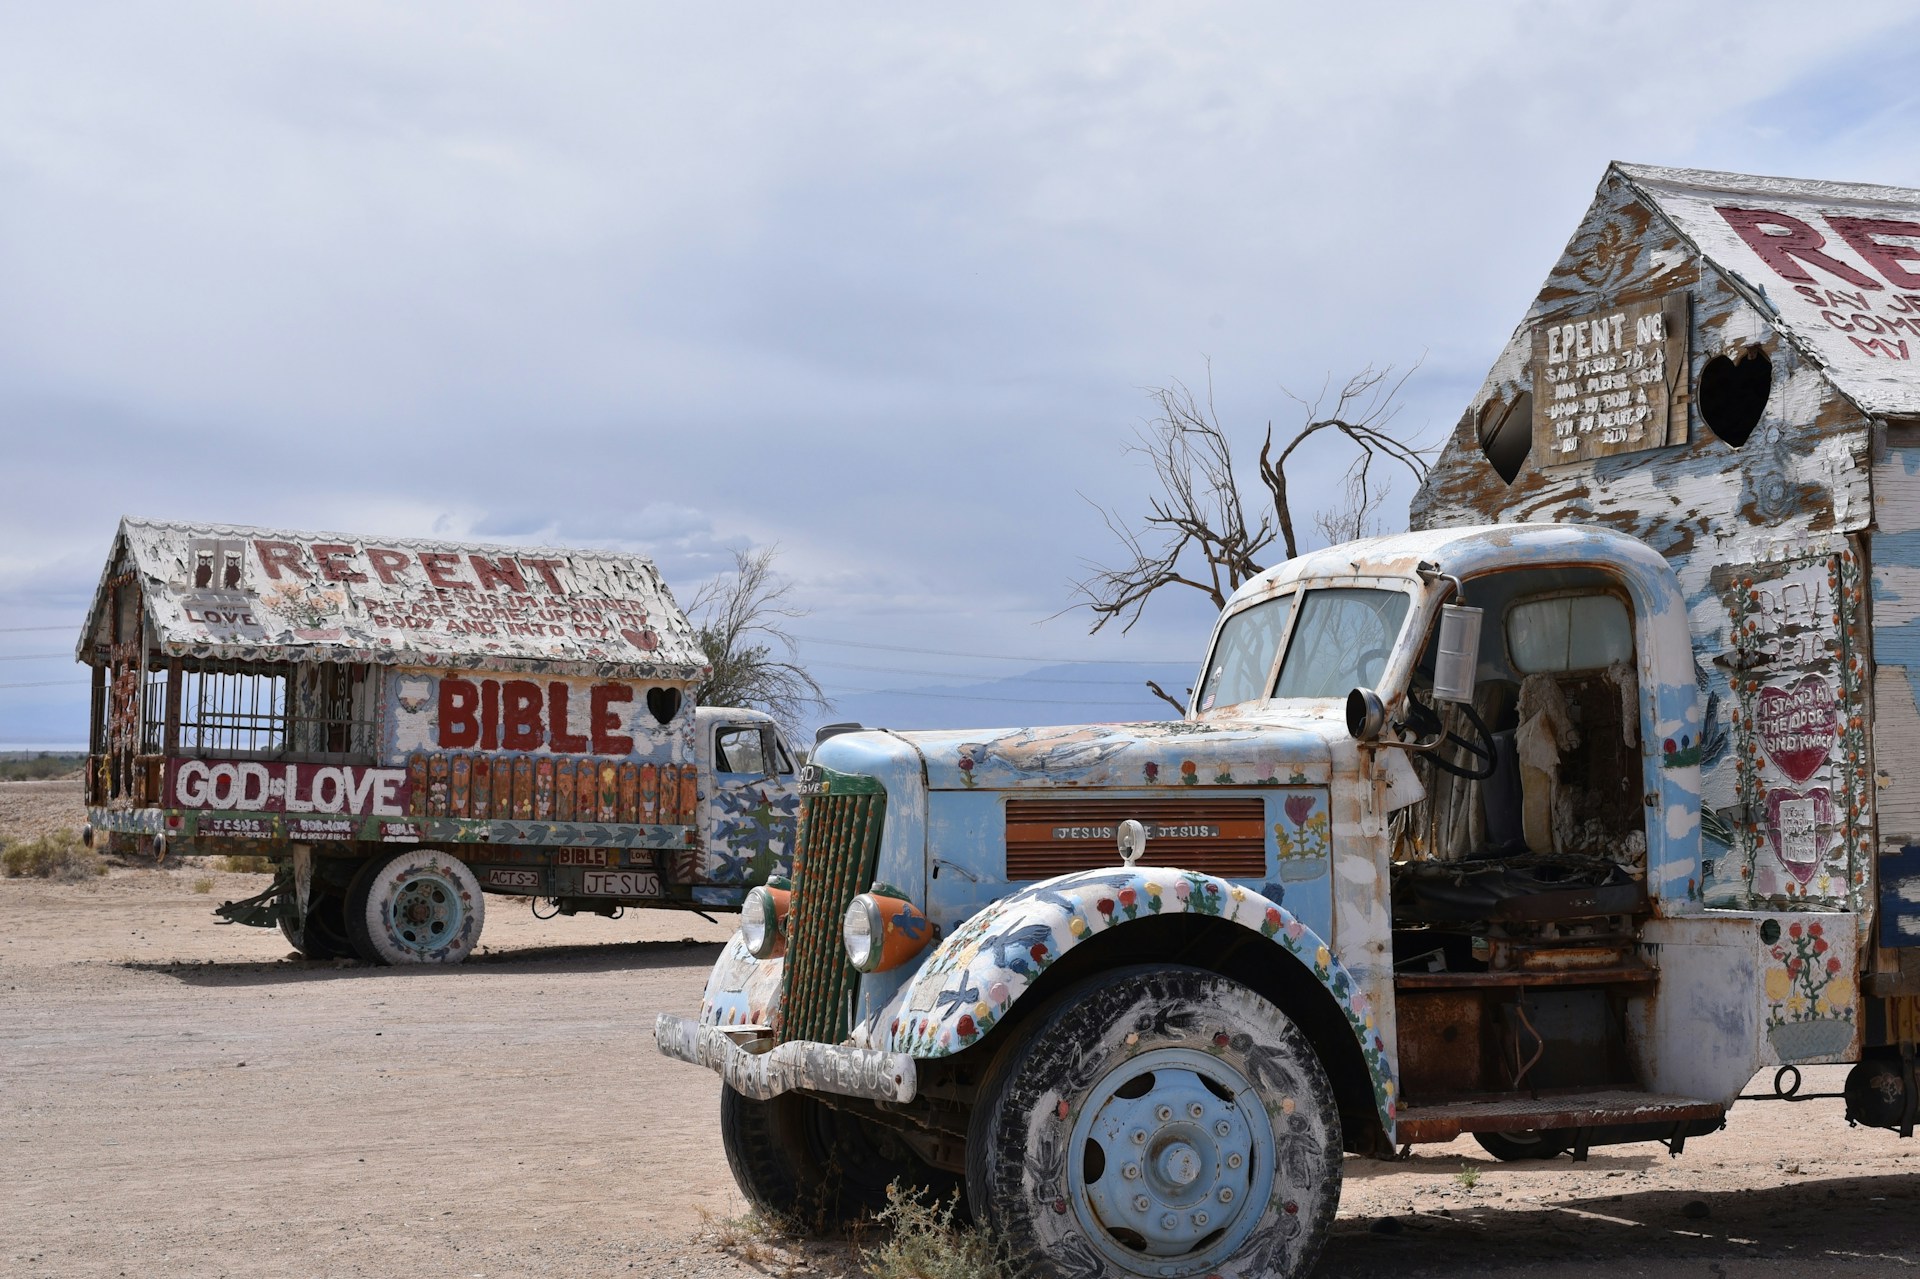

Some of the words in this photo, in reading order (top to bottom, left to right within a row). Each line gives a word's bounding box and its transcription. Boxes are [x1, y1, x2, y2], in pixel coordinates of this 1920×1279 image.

[1794, 285, 1871, 310] SAY
[1547, 313, 1626, 365] EPENT
[1847, 335, 1909, 360] MY
[254, 540, 565, 595] REPENT
[364, 599, 457, 617] PLEASE
[465, 605, 525, 621] COME
[538, 609, 602, 624] UPON
[618, 613, 647, 626] MY
[419, 589, 500, 607] JESUS
[567, 597, 646, 612] SINNER
[184, 608, 259, 626] LOVE
[374, 614, 435, 629] BODY
[446, 618, 498, 635] AND
[507, 622, 565, 636] INTO
[574, 624, 609, 637] MY
[1771, 687, 1813, 715] STAND
[438, 678, 634, 755] BIBLE
[1761, 717, 1788, 735] THE
[1790, 709, 1826, 729] DOOR
[1801, 734, 1833, 750] KNOCK
[176, 760, 270, 810] GOD
[285, 764, 407, 816] LOVE
[213, 819, 260, 831] JESUS
[1058, 827, 1111, 839] JESUS
[560, 849, 607, 865] BIBLE
[631, 851, 653, 860] LOVE
[490, 871, 538, 886] ACTS-2
[587, 873, 660, 894] JESUS
[824, 1049, 895, 1097] JESUS
